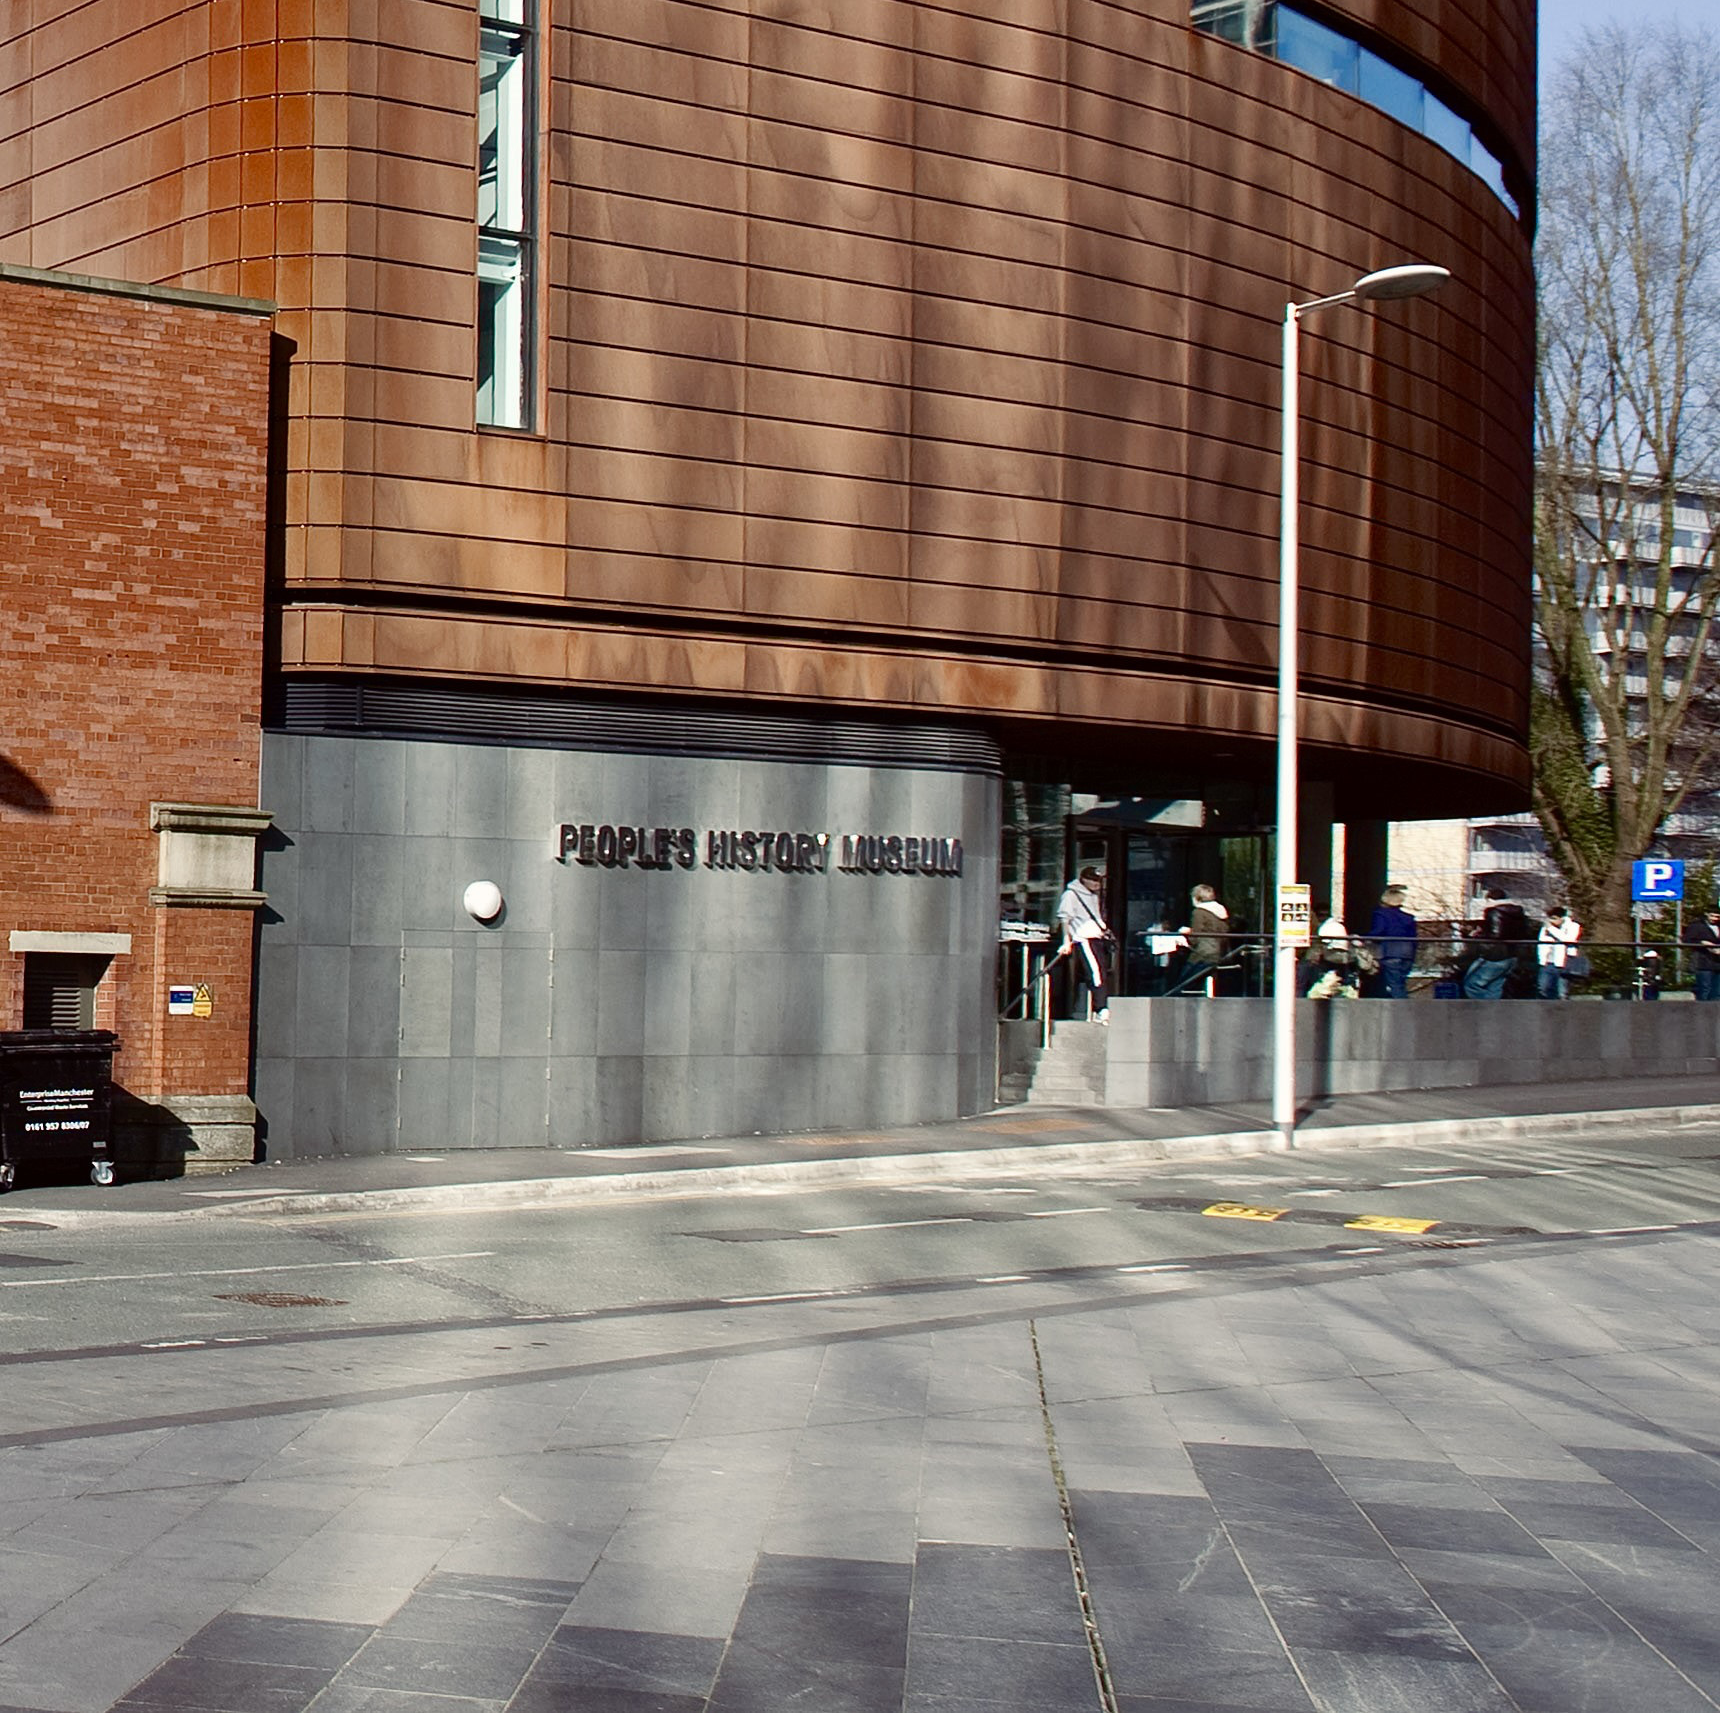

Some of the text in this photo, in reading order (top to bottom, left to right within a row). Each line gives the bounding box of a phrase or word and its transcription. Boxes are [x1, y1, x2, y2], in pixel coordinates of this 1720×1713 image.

[557, 824, 963, 876] PEOPLE'S HISTORY MUSEUM
[1645, 863, 1673, 889] P
[25, 1122, 44, 1131] 0161
[45, 1122, 60, 1131] 957
